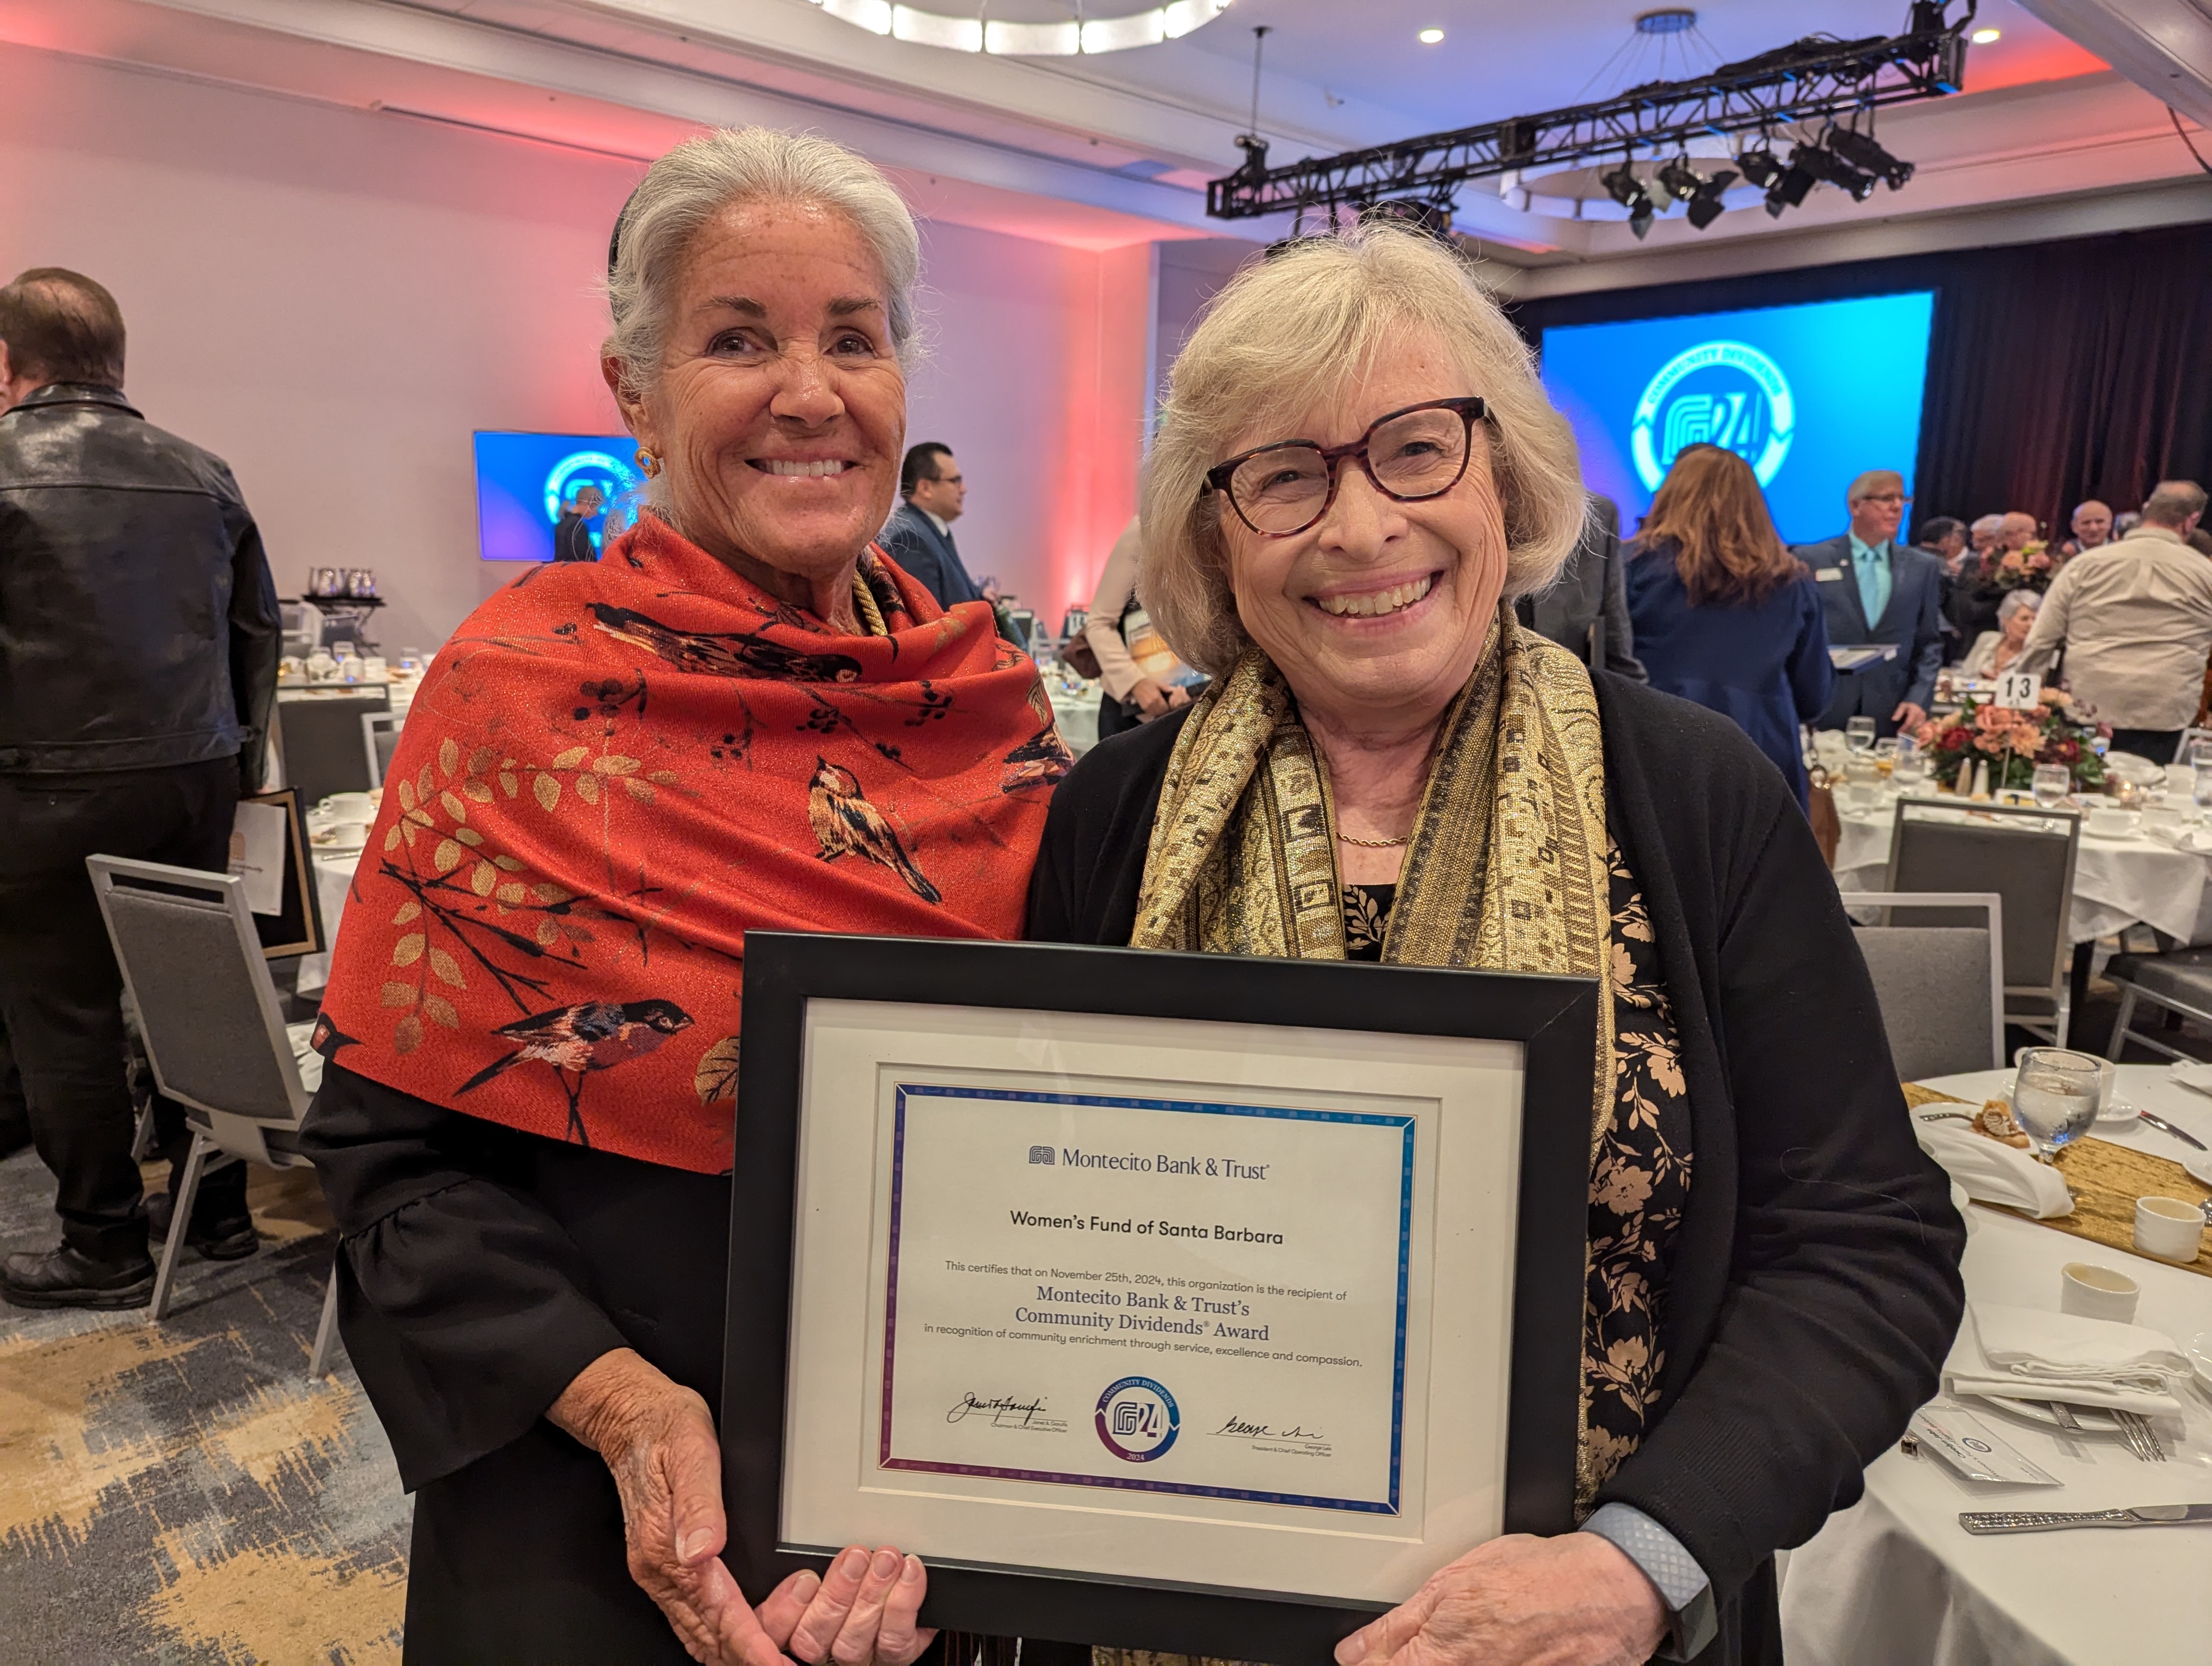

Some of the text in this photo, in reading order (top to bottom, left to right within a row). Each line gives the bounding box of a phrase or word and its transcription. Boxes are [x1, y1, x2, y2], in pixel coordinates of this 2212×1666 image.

[2006, 677, 2031, 698] 13
[1063, 1148, 1152, 1171] Montecito
[1157, 1155, 1201, 1175] Bank
[1205, 1158, 1218, 1176] &
[1010, 1210, 1283, 1244] Women's Fund of Santa Barbara
[946, 1260, 966, 1271] This
[968, 1264, 1008, 1274] certifies
[1011, 1266, 1032, 1276] that
[1051, 1268, 1102, 1280] November
[1105, 1272, 1131, 1284] 25th,
[1134, 1274, 1164, 1286] 2024,
[1166, 1277, 1186, 1287] this
[1188, 1281, 1253, 1292] organization
[1256, 1284, 1264, 1293] is
[1267, 1285, 1284, 1295] the
[1287, 1289, 1333, 1300] recipient
[1335, 1291, 1347, 1300] of
[1037, 1286, 1249, 1316] Montecito Bank & Trust's
[1016, 1307, 1114, 1331] Community
[1213, 1322, 1269, 1341] Award
[924, 1323, 1362, 1367] in recognition of community enrichment through service, excellence and compassion.
[1102, 1379, 1175, 1408] COMMUNITY DIVIDENDS
